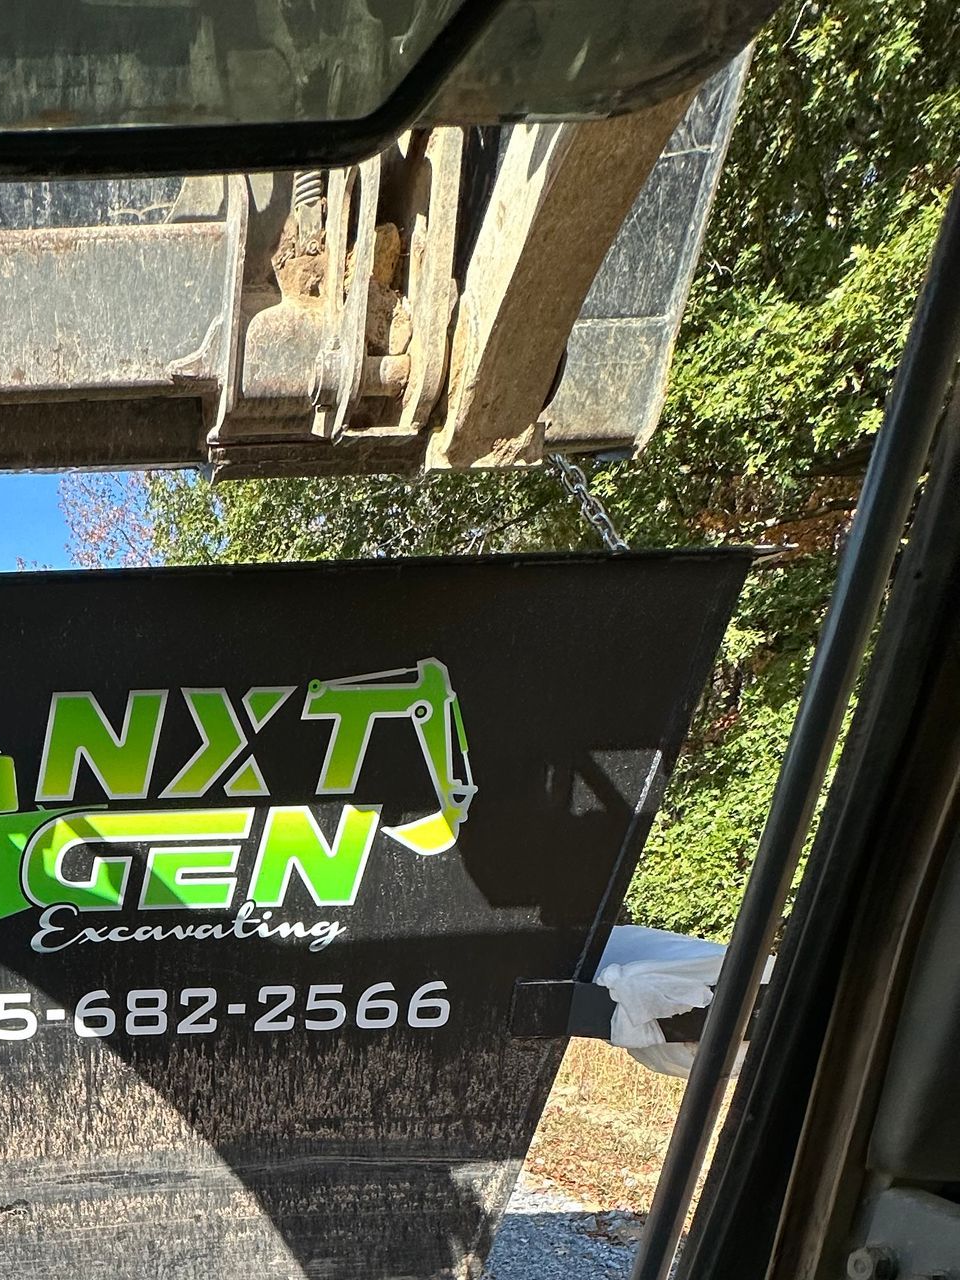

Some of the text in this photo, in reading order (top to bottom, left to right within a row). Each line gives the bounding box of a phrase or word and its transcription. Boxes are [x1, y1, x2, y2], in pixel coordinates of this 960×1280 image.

[35, 679, 440, 799] NXT
[20, 804, 383, 910] GEN
[31, 900, 346, 954] Excavating
